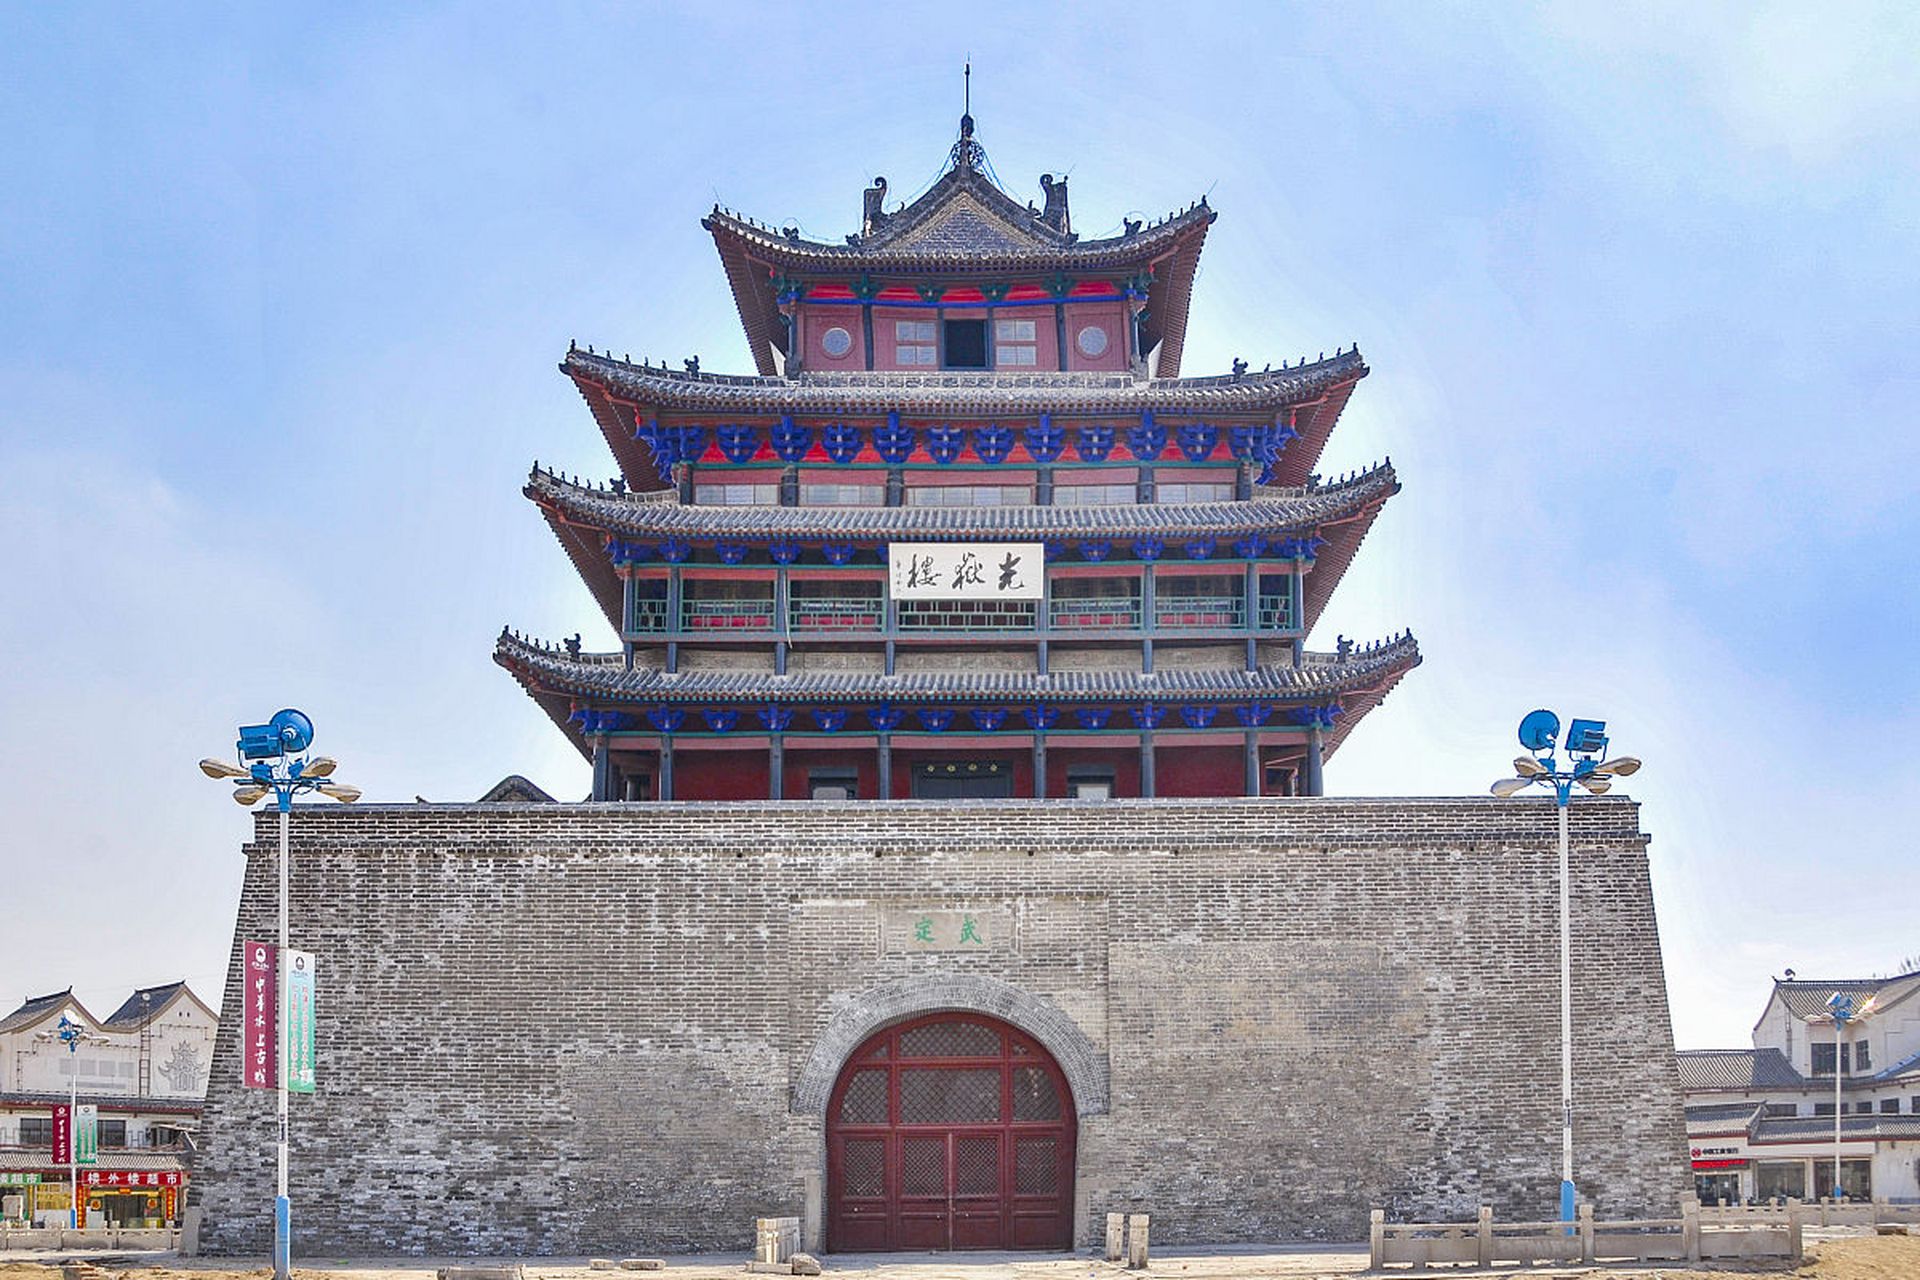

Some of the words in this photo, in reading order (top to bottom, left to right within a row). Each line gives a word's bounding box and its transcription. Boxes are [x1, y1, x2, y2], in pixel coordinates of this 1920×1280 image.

[914, 914, 983, 945] 武定
[87, 1172, 178, 1185] 楼外楼超市
